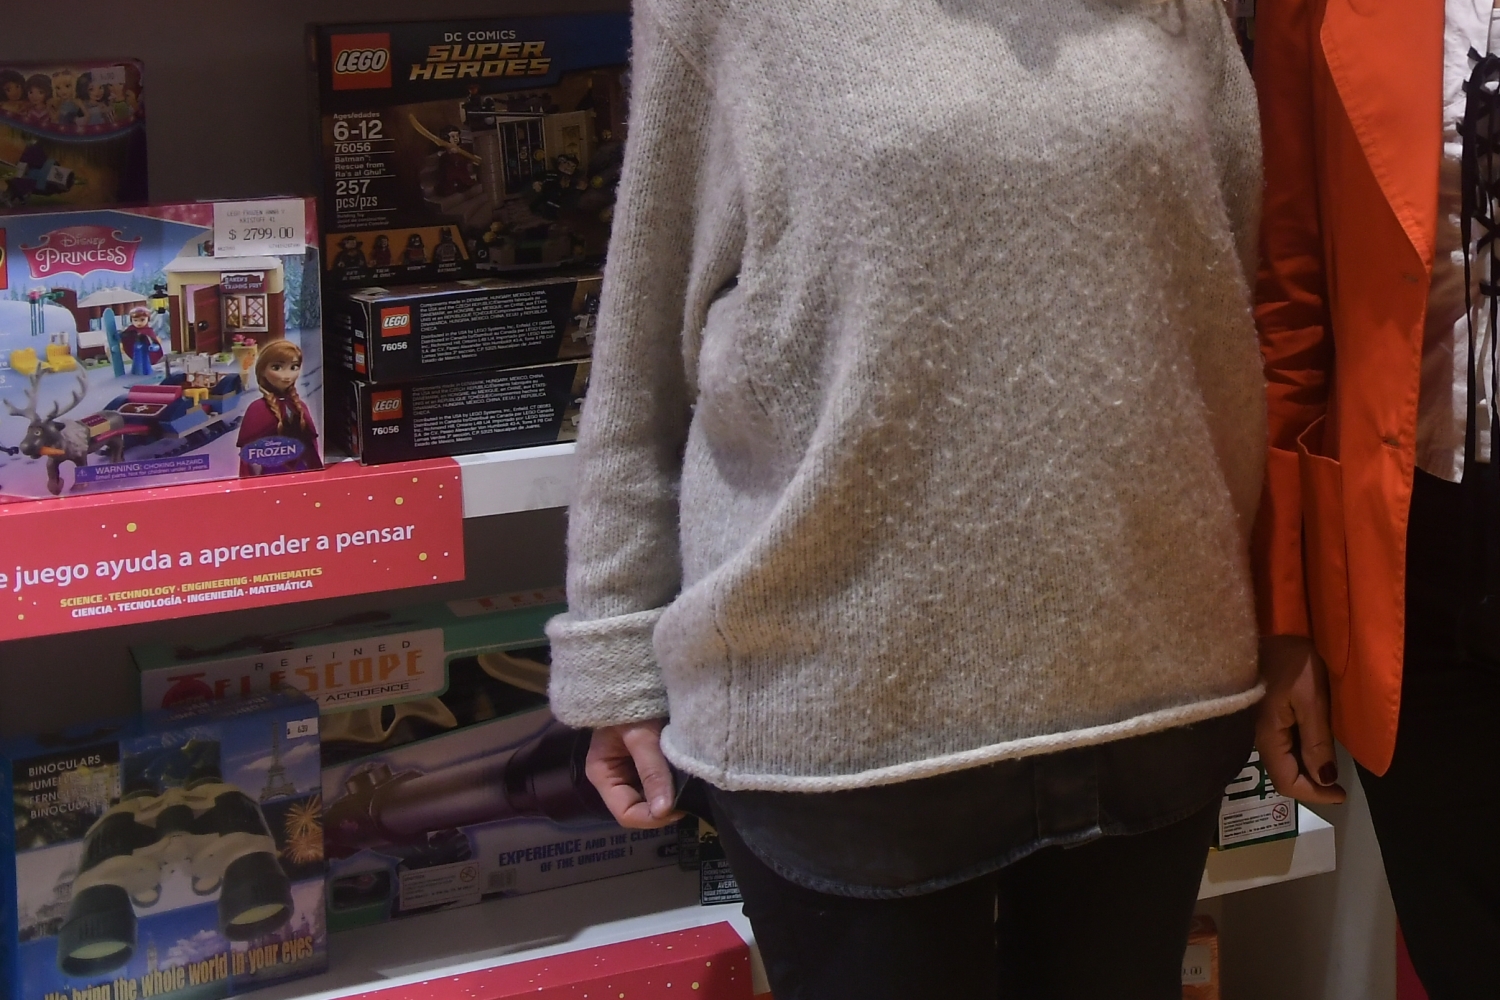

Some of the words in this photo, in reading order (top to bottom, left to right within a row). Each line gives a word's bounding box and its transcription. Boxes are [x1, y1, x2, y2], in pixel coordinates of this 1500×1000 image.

[445, 32, 462, 42] DC
[468, 30, 516, 40] COMICS
[427, 41, 545, 62] SUPER
[337, 49, 387, 73] LEGO
[410, 58, 551, 80] HEROES
[334, 120, 382, 141] 6-12
[335, 143, 371, 153] 76056
[336, 180, 371, 195] 257
[337, 196, 378, 211] pcs/pzs
[244, 227, 294, 241] 2799.00
[36, 245, 126, 272] PRINCESS
[383, 314, 408, 328] LEGO
[381, 342, 407, 351] 76056
[374, 398, 400, 411] LEGO
[372, 426, 399, 435] 76056
[248, 444, 296, 459] FROZEN
[95, 464, 142, 474] WARNING:
[144, 461, 174, 470] CHOKING
[176, 458, 203, 467] HAZARD
[14, 564, 88, 591] juego
[96, 549, 172, 577] ayuda
[179, 552, 193, 567] a
[199, 535, 309, 566] aprender
[316, 536, 330, 549] a
[336, 522, 414, 552] pensar
[61, 594, 102, 607] SCIENCE
[109, 585, 175, 600] TECHNOLOGY
[182, 577, 247, 591] ENGINEERING
[253, 567, 322, 582] MATHEMATICS
[72, 604, 112, 617] CIENCIA
[118, 594, 182, 611] TECNOLOGÍA
[187, 587, 244, 603] INGENIERÍA
[249, 579, 313, 594] MATEMÁTICA
[28, 754, 100, 777] BINOCULARS
[499, 839, 582, 866] EXPERIENCE
[114, 977, 138, 999] the
[142, 966, 184, 992] whole
[189, 956, 227, 981] world
[248, 947, 278, 978] your
[281, 936, 313, 965] eyes
